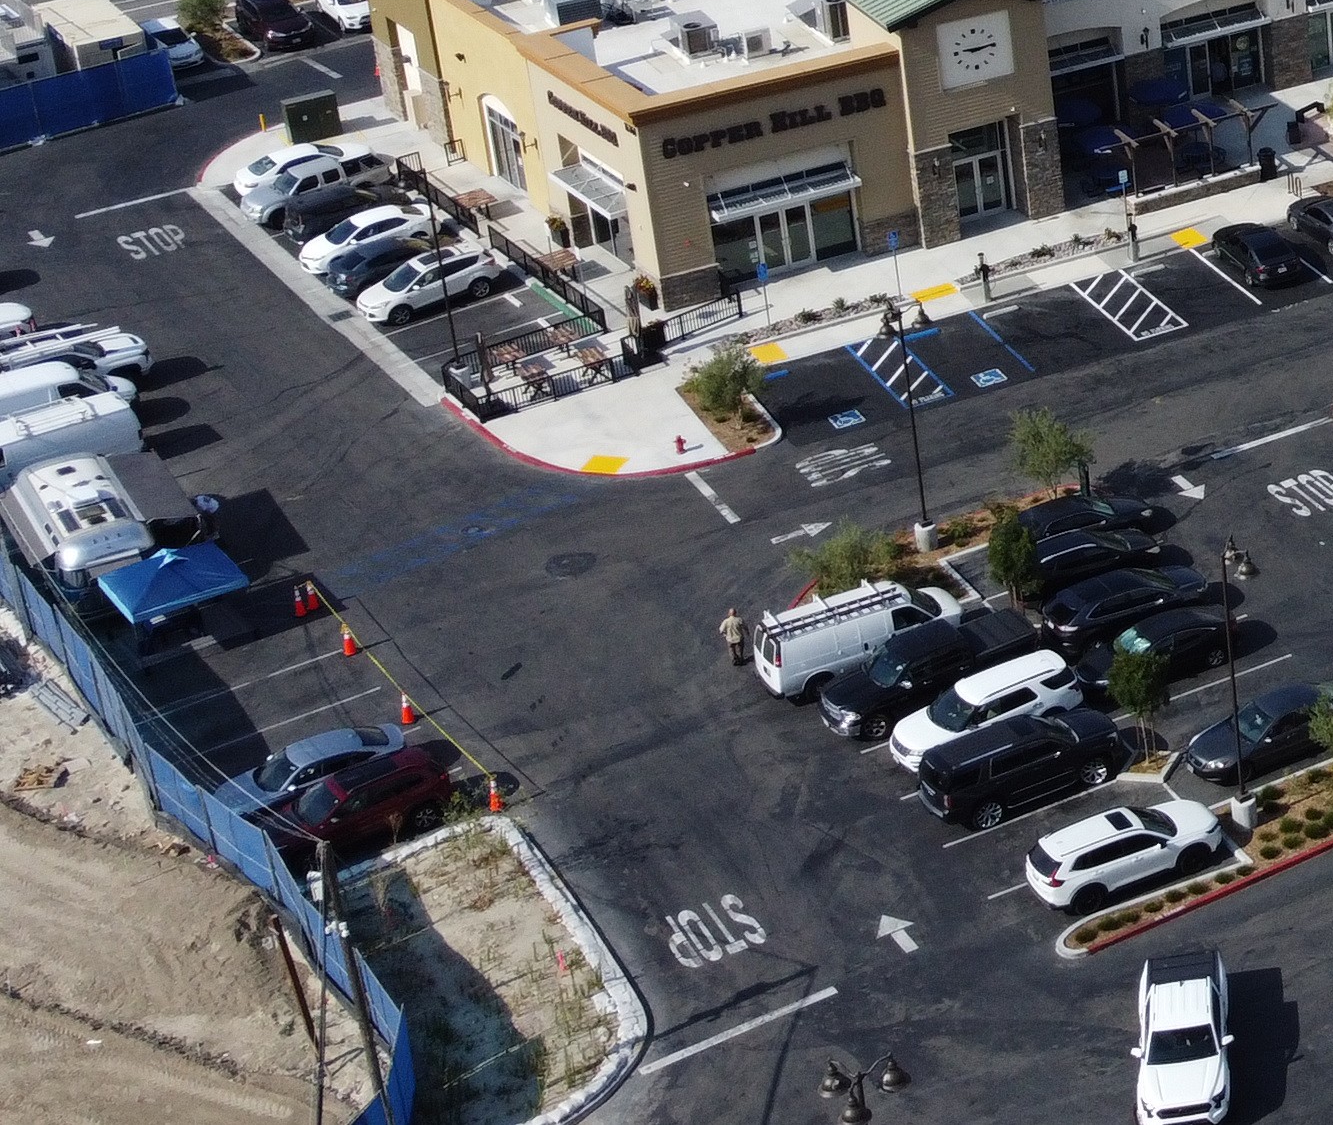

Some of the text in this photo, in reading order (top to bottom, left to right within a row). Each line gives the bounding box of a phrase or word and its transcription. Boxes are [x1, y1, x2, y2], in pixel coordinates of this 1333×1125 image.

[662, 120, 764, 159] COPPER
[769, 104, 832, 135] HILL
[838, 87, 886, 117] BBQ
[117, 224, 185, 260] STOP
[665, 894, 767, 968] STOP
